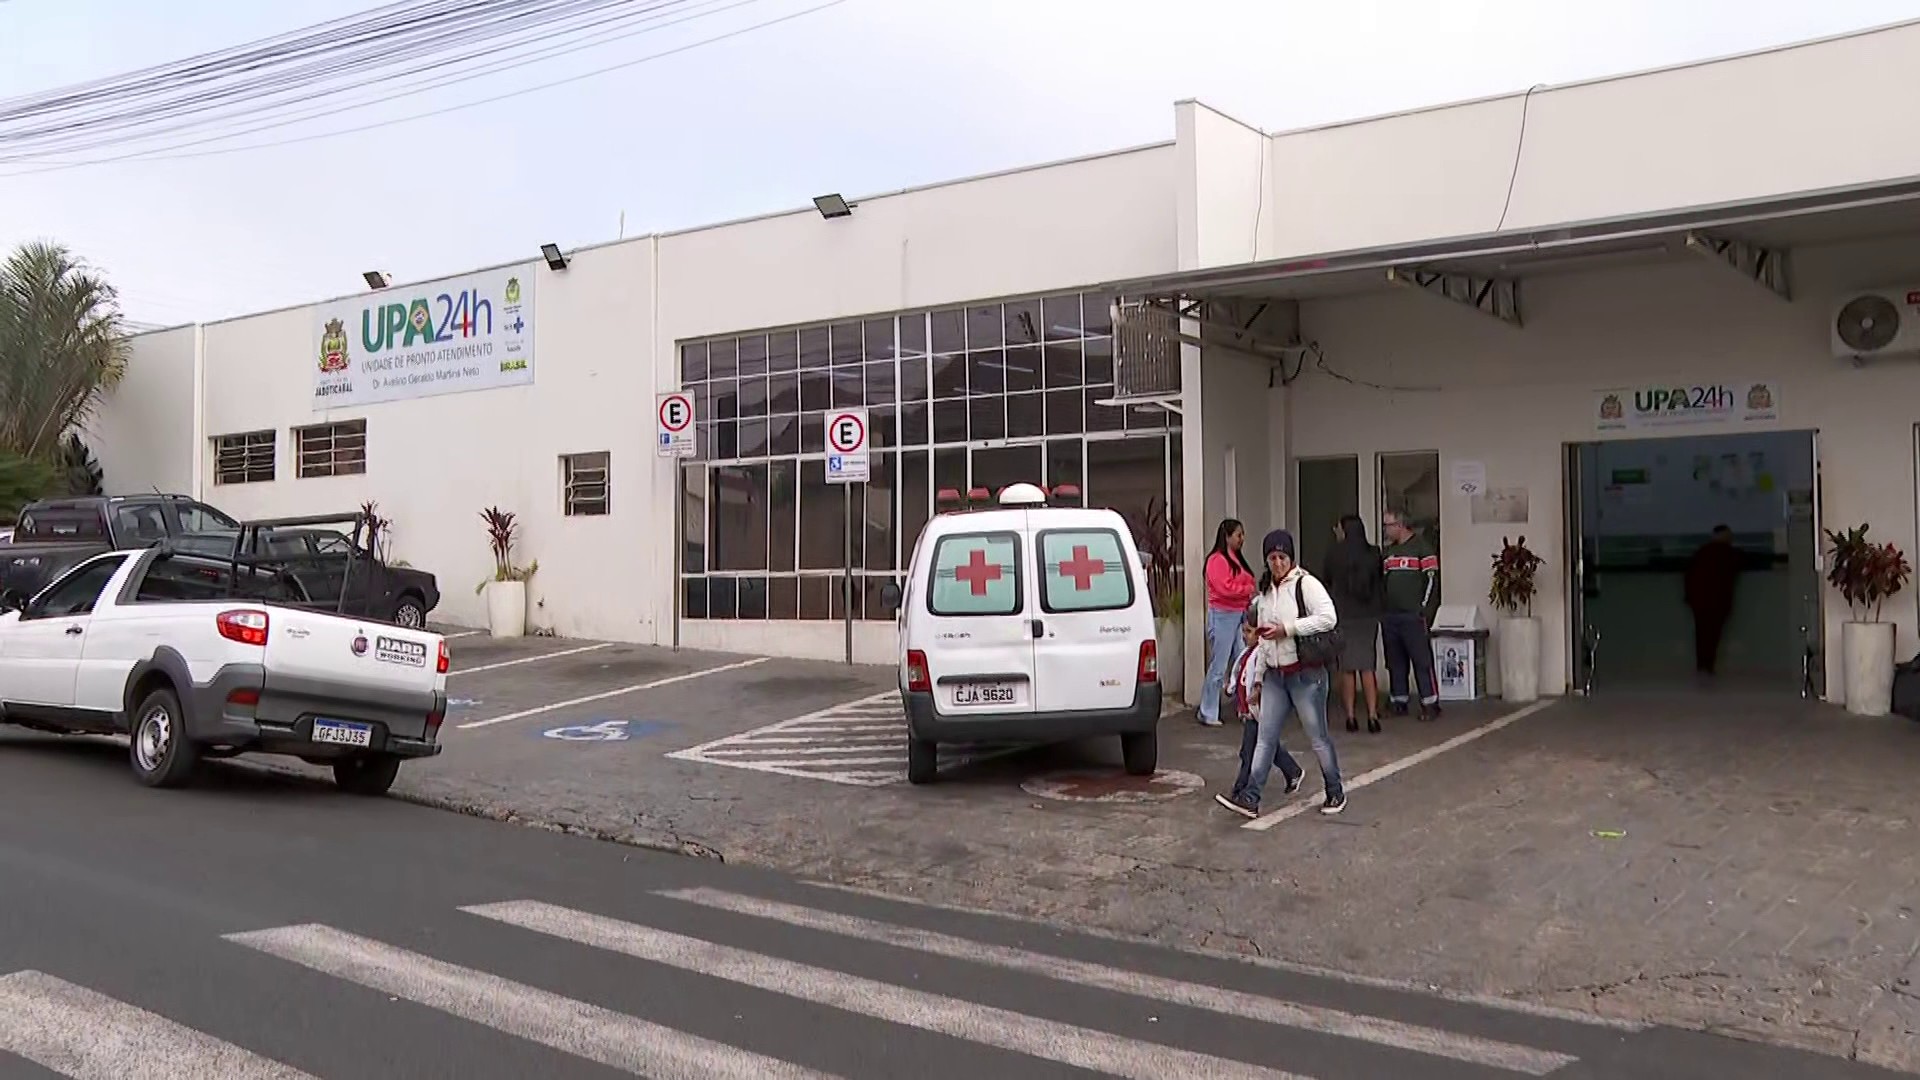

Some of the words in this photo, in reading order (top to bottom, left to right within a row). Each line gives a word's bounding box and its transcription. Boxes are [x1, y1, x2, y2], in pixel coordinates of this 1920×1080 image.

[361, 357, 393, 374] UNIDADE
[394, 355, 404, 369] DE
[406, 350, 436, 367] PRONTO
[437, 342, 493, 361] ATENDIMENTO
[669, 403, 682, 424] E
[840, 422, 854, 445] E
[379, 637, 425, 655] HARD
[380, 651, 422, 664] WORKING
[956, 690, 979, 703] CJA
[982, 688, 1014, 701] 9620
